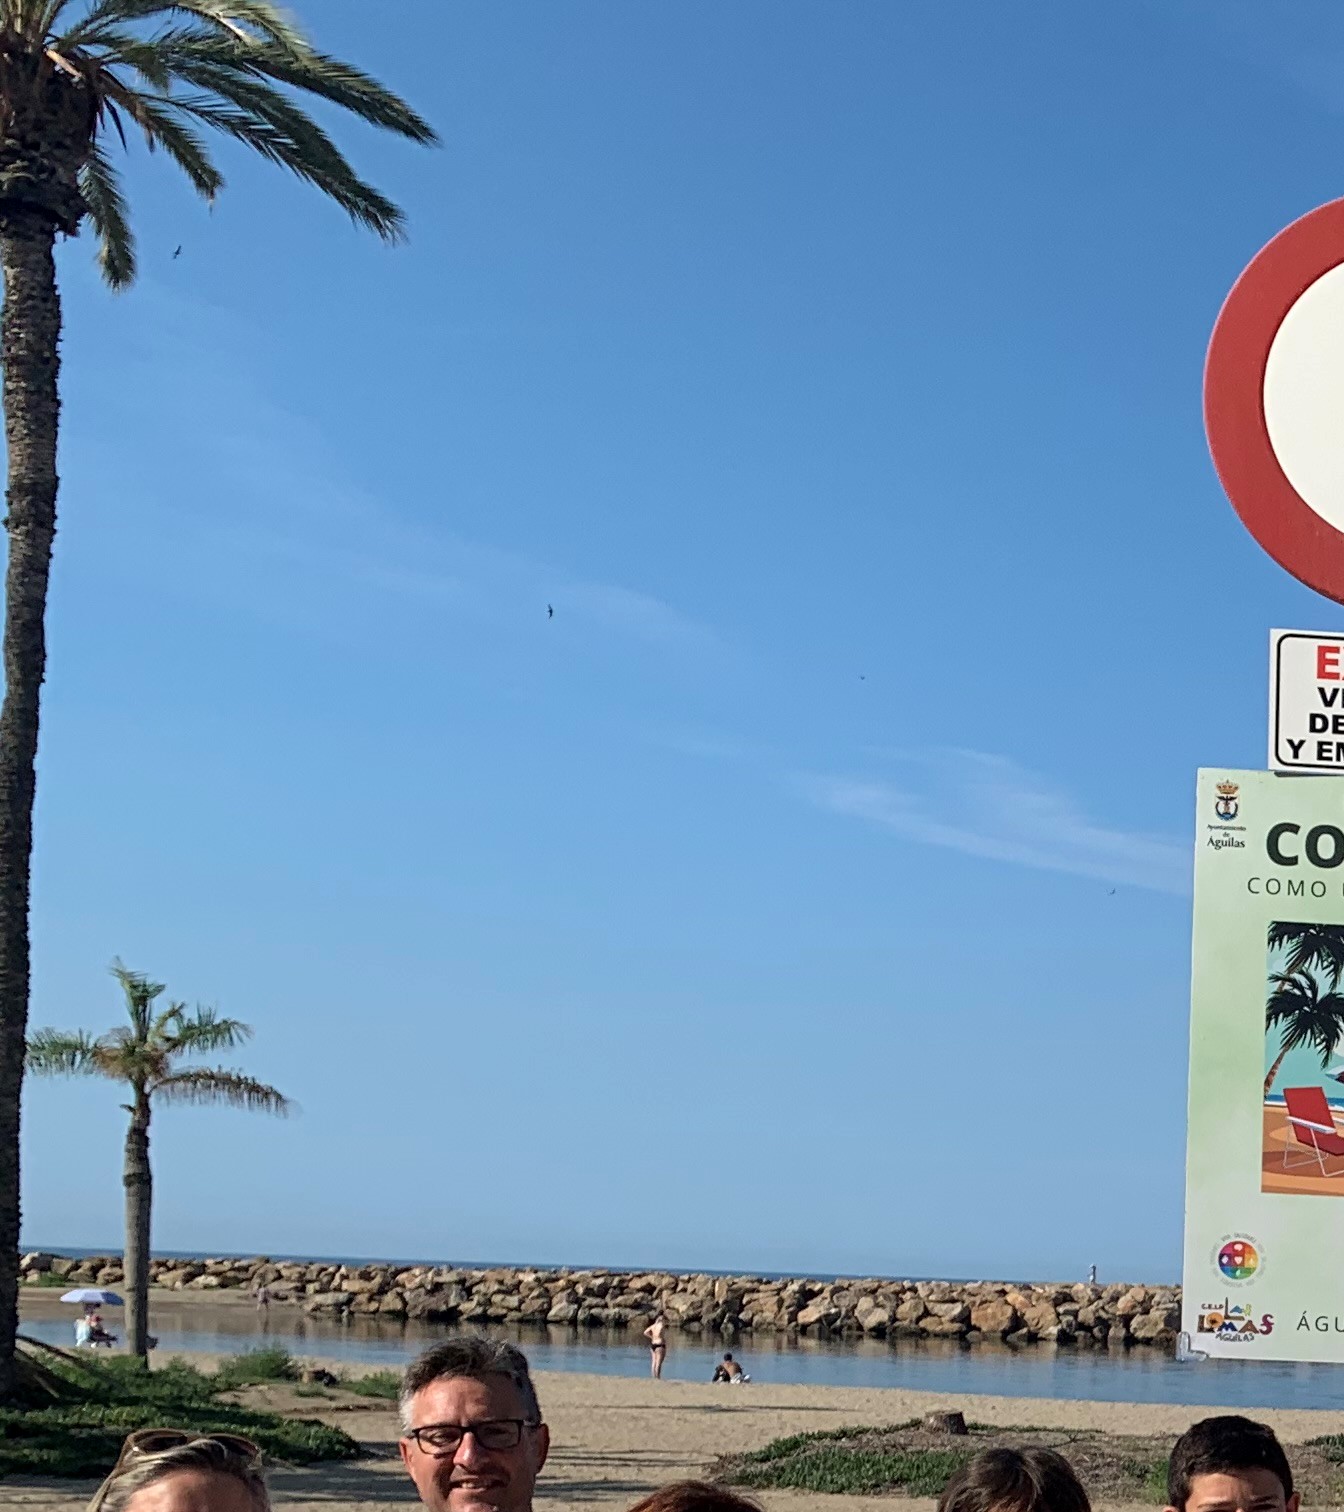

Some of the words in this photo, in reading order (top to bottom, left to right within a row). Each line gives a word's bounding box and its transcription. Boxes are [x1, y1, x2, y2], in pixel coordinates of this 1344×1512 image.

[1286, 739, 1306, 760] Y
[1207, 836, 1246, 850] Águilas
[1247, 876, 1328, 898] COMO
[1197, 1311, 1274, 1335] LOMAS
